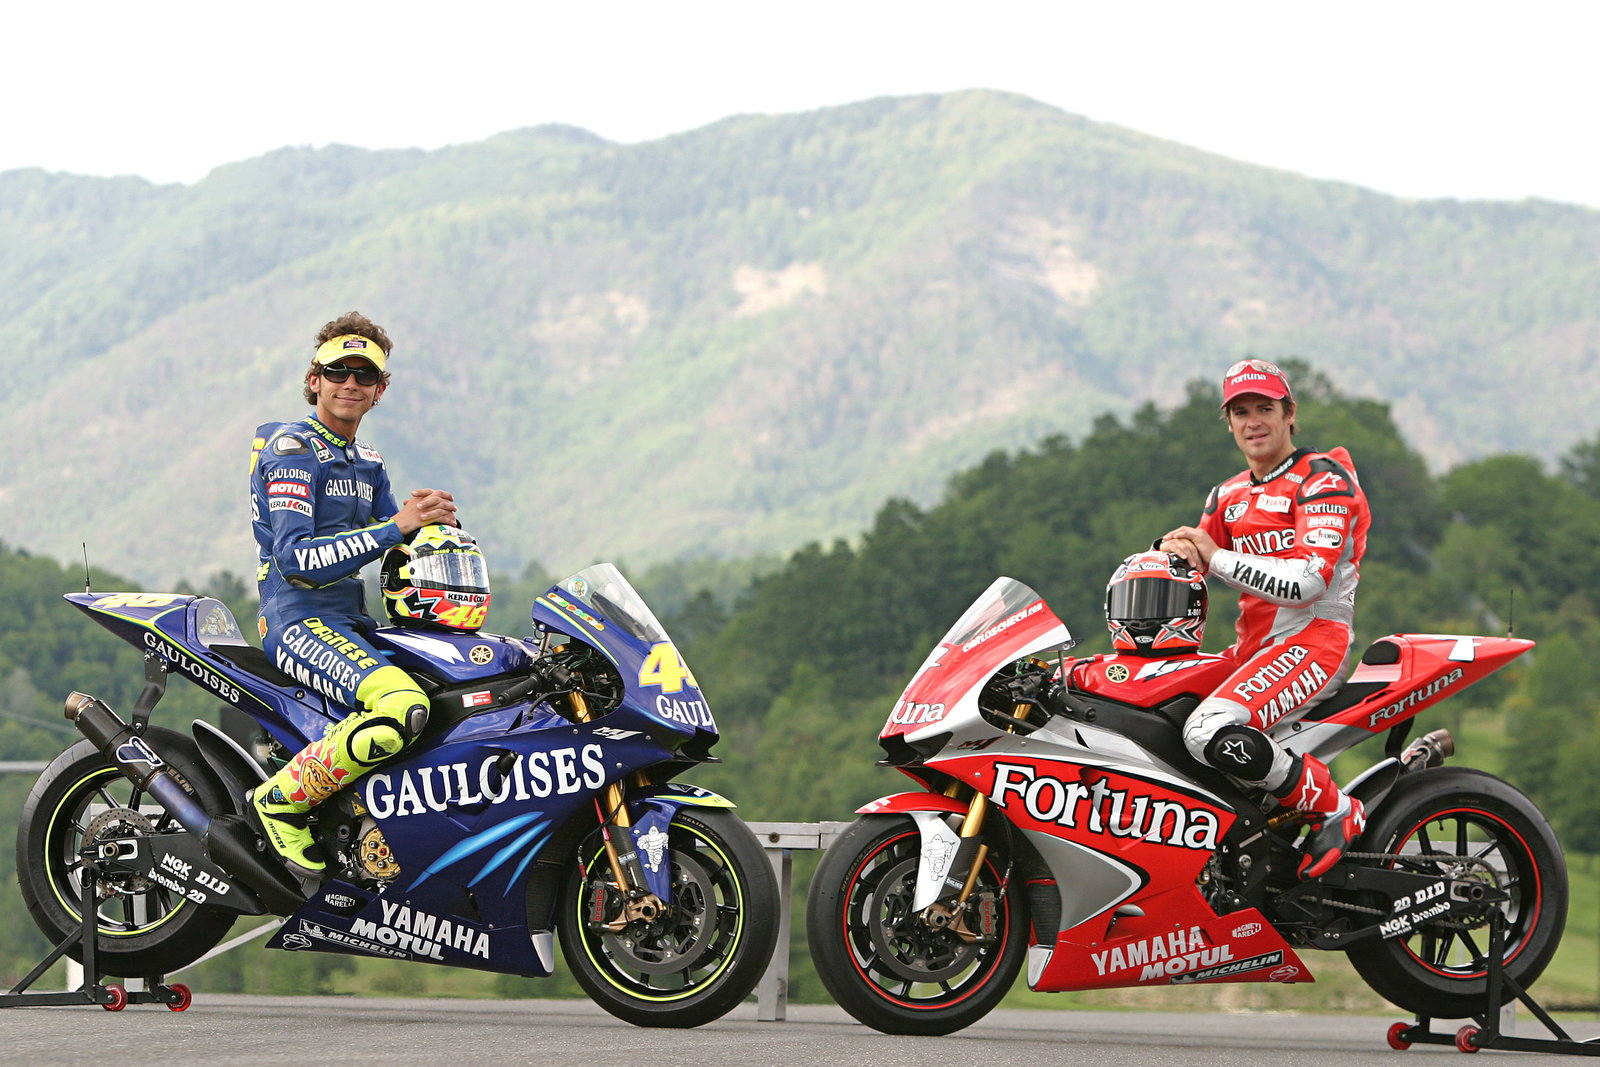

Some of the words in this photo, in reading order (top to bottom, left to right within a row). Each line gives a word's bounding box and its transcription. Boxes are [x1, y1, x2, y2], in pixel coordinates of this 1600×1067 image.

[268, 483, 307, 496] MOTUL
[1304, 503, 1347, 514] Fortuna
[1307, 517, 1342, 528] MOTUL
[294, 531, 380, 571] YAMAHA
[1232, 561, 1302, 600] YAMAHA
[437, 605, 488, 628] 46
[143, 631, 240, 704] GAULOISES
[276, 645, 348, 706] YAMAHA
[282, 624, 360, 692] GAULOISES
[638, 641, 698, 694] 4
[1233, 644, 1309, 702] Fortuna
[1256, 661, 1329, 728] YAMAHA
[1369, 668, 1465, 728] Fortuna
[364, 743, 607, 820] GAULOISES
[990, 762, 1220, 851] Fortuna
[163, 852, 192, 877] NGK
[148, 867, 186, 895] brembo
[187, 889, 207, 905] 2D
[1394, 896, 1411, 913] 2D
[381, 899, 490, 960] YAMAHA
[1380, 914, 1410, 936] NGK
[1411, 901, 1451, 924] brembo
[328, 931, 407, 959] MICHELIN
[350, 918, 444, 961] MOTUL
[1090, 925, 1207, 977] YAMAHA
[1139, 944, 1235, 983] MOTUL
[1196, 953, 1281, 979] MICHELIN
